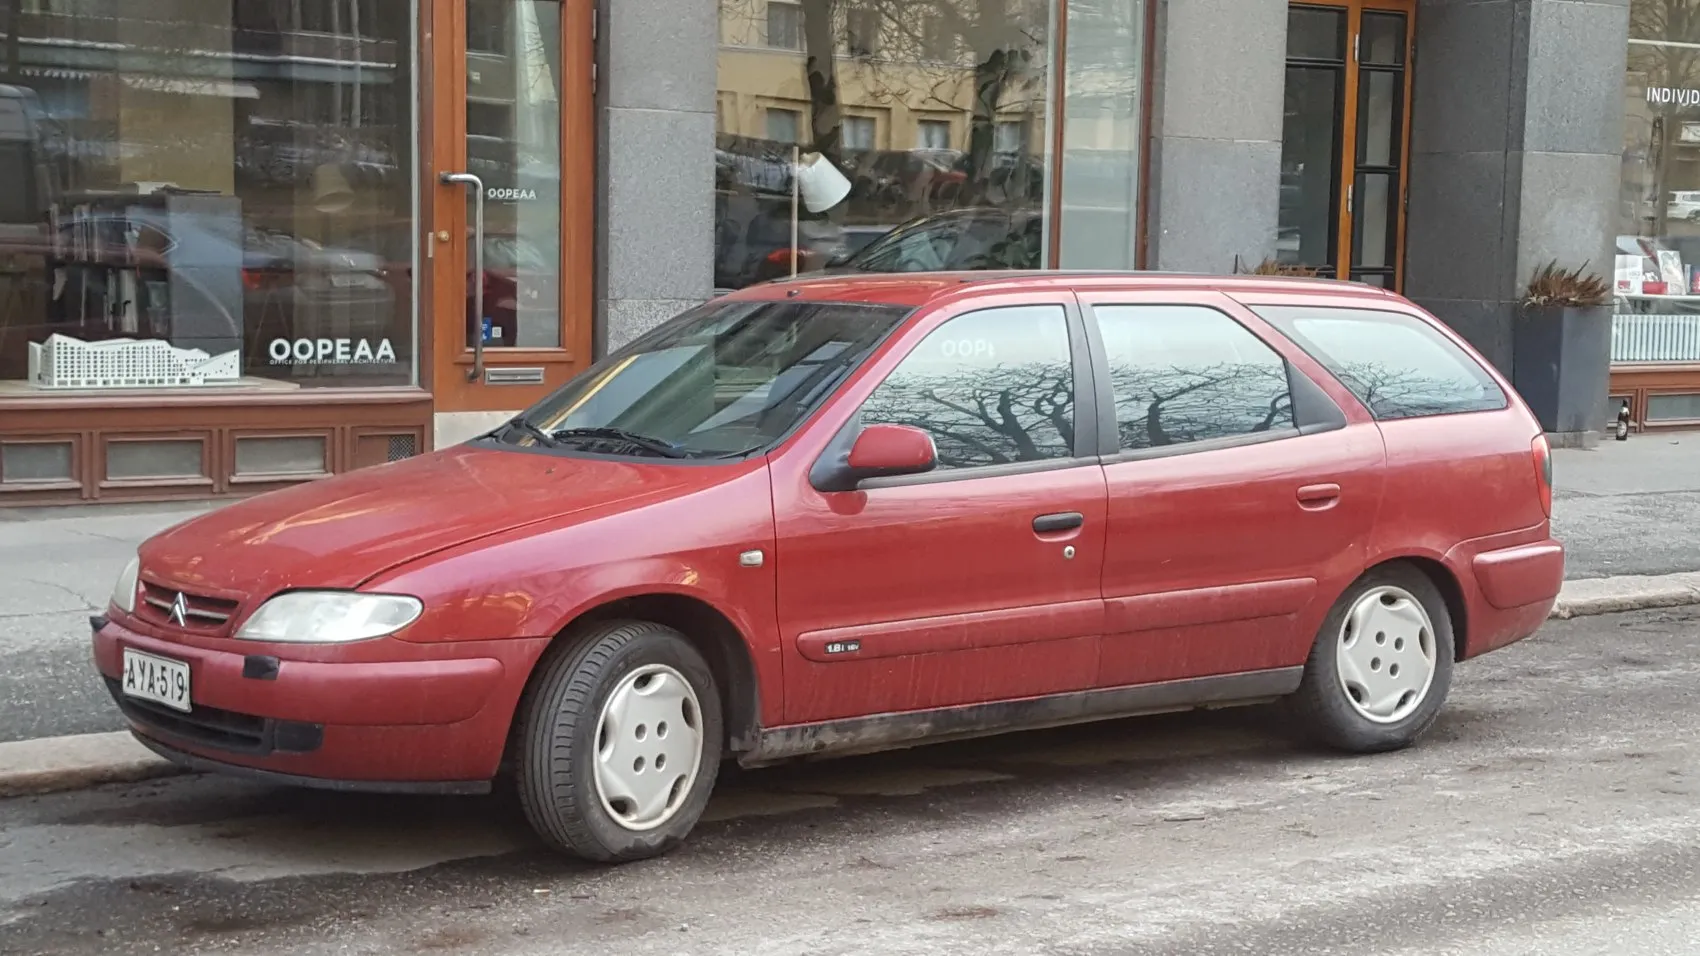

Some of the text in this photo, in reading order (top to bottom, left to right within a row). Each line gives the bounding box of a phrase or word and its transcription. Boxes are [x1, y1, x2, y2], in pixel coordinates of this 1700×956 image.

[487, 187, 537, 200] OOPEAA
[269, 338, 396, 361] OOPEAA
[126, 657, 185, 702] AYA-519
